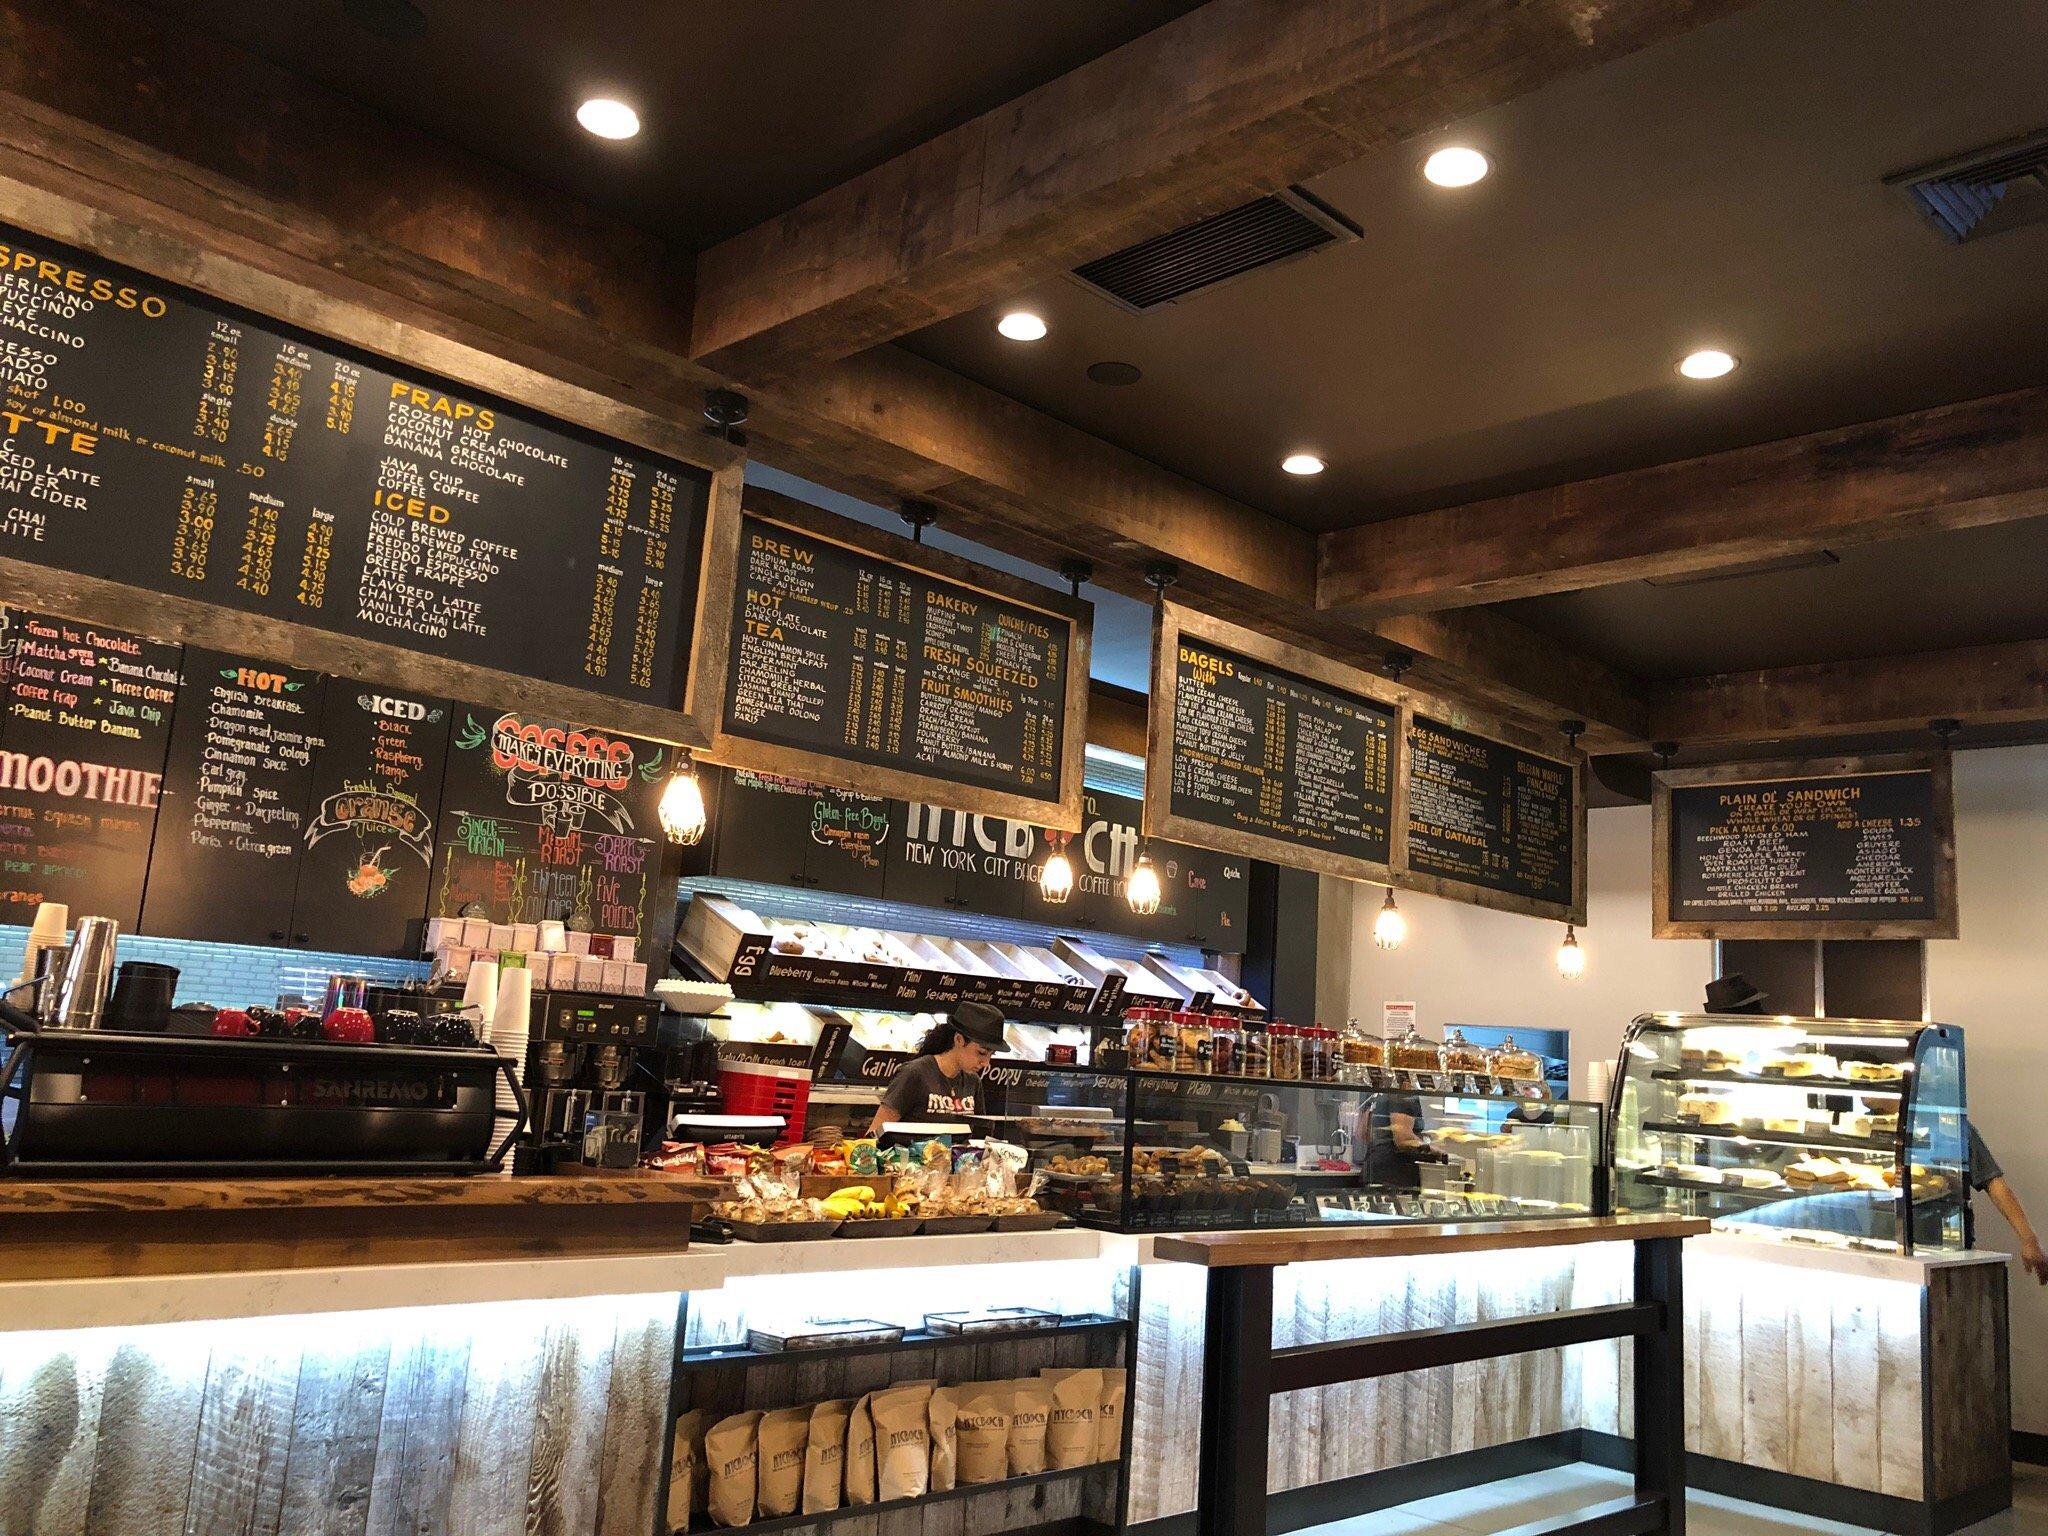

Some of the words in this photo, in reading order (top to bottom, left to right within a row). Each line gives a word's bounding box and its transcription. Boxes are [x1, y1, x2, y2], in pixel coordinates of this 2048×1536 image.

[390, 382, 495, 431] FRAPS
[50, 410, 98, 431] almond
[104, 426, 130, 441] milk
[200, 452, 226, 468] milk
[386, 425, 440, 449] MATCHA
[451, 445, 495, 465] GREEN
[388, 413, 452, 443] COCONUT
[460, 435, 507, 458] CREAM
[389, 402, 452, 430] FROZEN
[463, 425, 491, 441] HOT
[499, 436, 568, 468] CHOCOLATE
[380, 456, 418, 473] JAVA
[430, 469, 463, 486] CHIP
[384, 434, 442, 461] BANANA
[451, 454, 524, 486] CHOCOLATE
[47, 463, 101, 487] LATTE
[186, 475, 214, 488] small
[378, 477, 426, 498] COFFEE
[379, 466, 424, 486] TOFFEE
[433, 480, 480, 503] COFFEE
[31, 486, 87, 511] CIDER
[182, 500, 215, 517] 3.90
[183, 488, 217, 504] 3.65
[249, 491, 284, 508] medium
[374, 489, 450, 524] ICED
[8, 508, 45, 526] CHAI
[179, 511, 213, 529] 3.00
[175, 536, 208, 554] 3.65
[177, 524, 210, 542] 3.90
[370, 522, 405, 540] HOME
[412, 532, 462, 555] BREWED
[469, 548, 491, 562] TEA
[372, 510, 405, 528] COLD
[411, 521, 465, 545] BREWED
[473, 537, 518, 560] COFFEE
[173, 548, 206, 566] 3.90
[368, 532, 420, 555] FREDDO
[427, 546, 499, 575] CAPPUCCINO
[751, 535, 814, 564] BREW
[171, 562, 205, 581] 3.65
[365, 553, 408, 573] GREEK
[415, 566, 464, 588] FRAPPE
[367, 542, 420, 564] FREDDO
[427, 557, 488, 583] ESPRESSO
[750, 557, 772, 571] DARK
[774, 565, 797, 576] ROAST
[751, 551, 787, 567] MEDIUM
[792, 562, 814, 574] ROAST
[359, 586, 393, 605] CHAI
[399, 595, 425, 612] TEA
[433, 602, 477, 624] LATTE
[361, 574, 433, 601] FLAVORED
[442, 595, 481, 613] LATTE
[747, 589, 782, 610] HOT
[927, 591, 978, 616] BAKERY
[357, 609, 447, 639] MOCHACCINO
[359, 597, 413, 619] VANILLA
[422, 611, 448, 627] CHAI
[453, 617, 487, 637] LATTE
[745, 610, 769, 624] DARK
[772, 617, 828, 638] CHOCOLATE
[746, 603, 800, 624] CHOCOLATE
[63, 627, 80, 644] hot
[745, 620, 784, 641] TEA
[742, 634, 757, 645] HOT
[760, 638, 799, 656] CINNAMON
[802, 648, 825, 661] SPICE
[742, 643, 772, 658] ENGLISH
[776, 650, 828, 669] BREAKFAST
[924, 645, 960, 665] FRESH
[967, 660, 1038, 689] SQUEEZED
[1180, 648, 1233, 676] BAGELS
[236, 667, 288, 694] HOT
[1179, 676, 1204, 689] BUTTER
[1193, 666, 1216, 685] With
[371, 695, 426, 721] ICED
[921, 678, 951, 696] FRUIT
[953, 686, 1013, 713] SMOOTHIES
[58, 711, 97, 731] Butter
[498, 734, 541, 764] MAKES
[1429, 732, 1487, 759] SANDWICHES
[915, 753, 935, 764] ACAI
[528, 783, 605, 810] POSSIBLE
[1720, 793, 1757, 806] PLAIN
[1787, 787, 1861, 802] SANDWICH
[1409, 820, 1428, 834] STEEL
[1431, 826, 1443, 837] CUT
[1445, 830, 1489, 848] OATMEAL
[1709, 827, 1728, 835] PICK
[1742, 825, 1766, 833] MEAT
[468, 835, 505, 858] ORIGIN
[605, 853, 643, 875] ROAST
[906, 841, 934, 865] NEW
[940, 847, 977, 873] YORK
[984, 856, 1009, 879] CITY
[1079, 874, 1110, 894] COFFEE
[769, 964, 812, 981] Blueberry
[896, 986, 916, 998] Plain
[925, 988, 958, 1002] Sesame
[1064, 1000, 1086, 1013] Poppy
[981, 1064, 1022, 1086] Poppy
